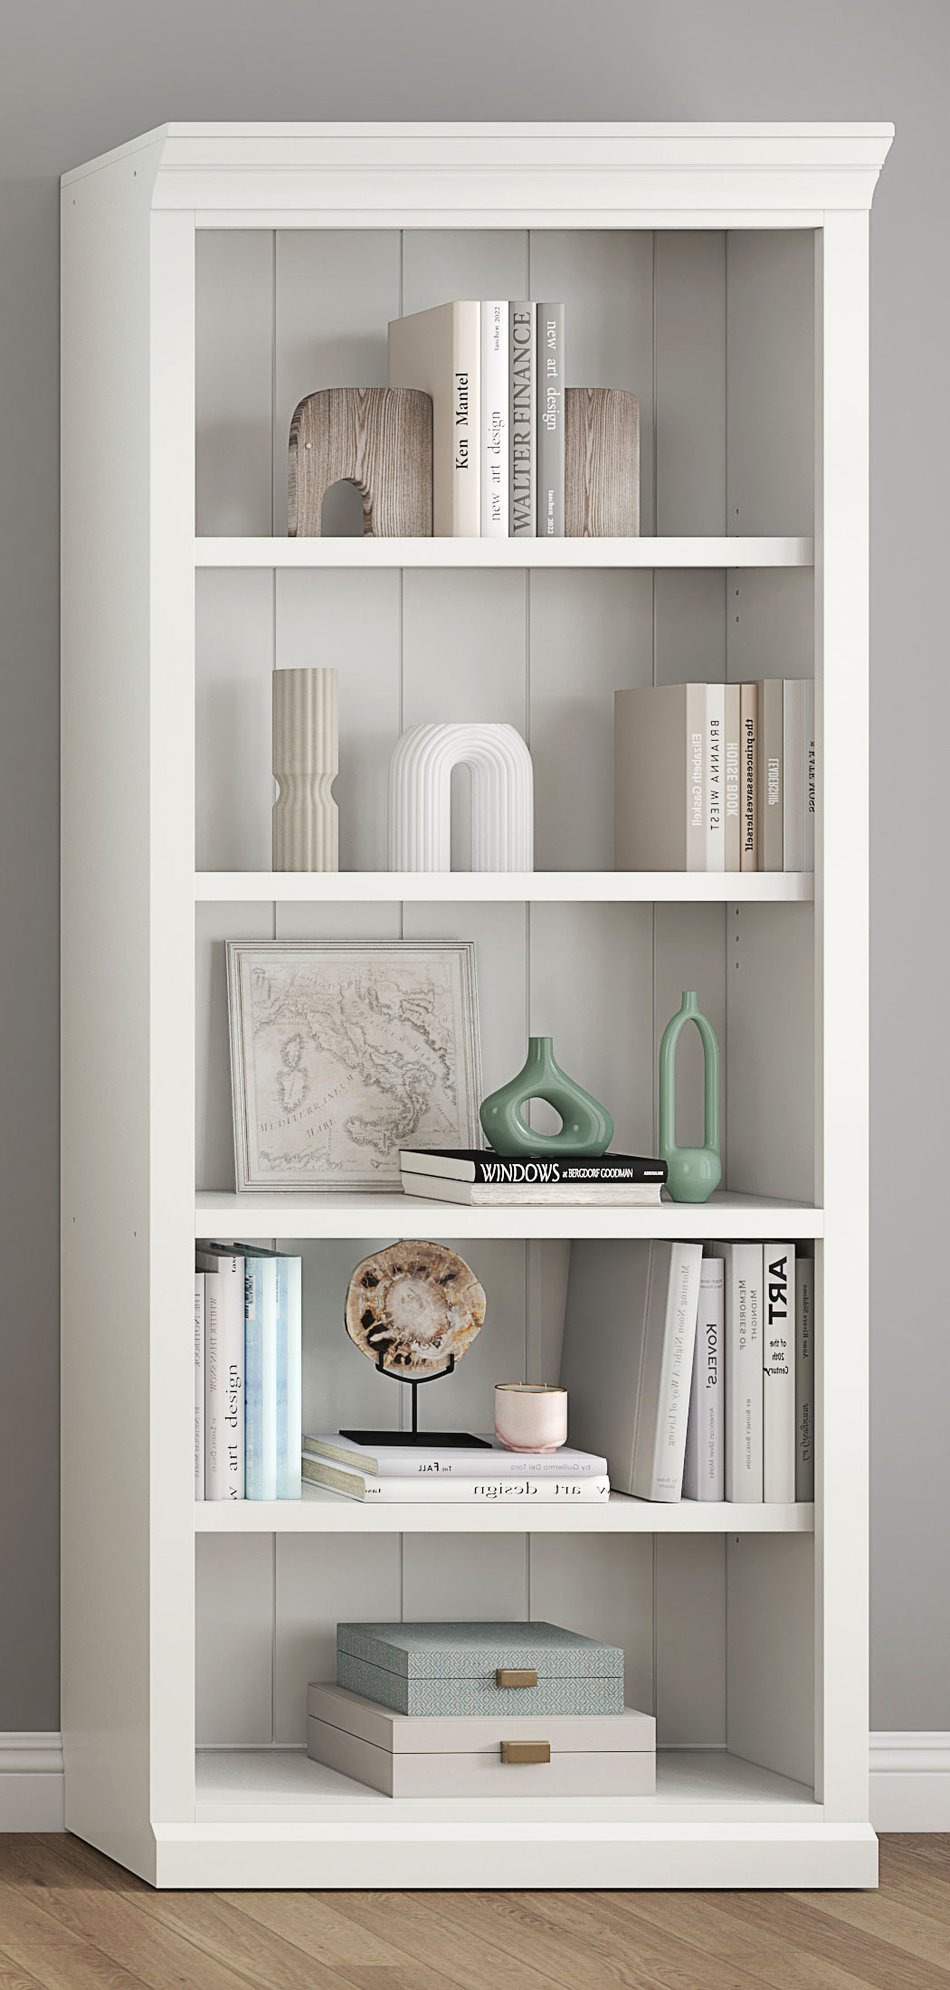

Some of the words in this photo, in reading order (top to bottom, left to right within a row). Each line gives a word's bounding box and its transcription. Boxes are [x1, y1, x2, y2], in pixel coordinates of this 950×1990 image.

[547, 321, 557, 350] new
[514, 311, 531, 426] FINANCE
[547, 358, 558, 378] art
[456, 373, 469, 426] Mantel
[543, 387, 560, 430] design
[487, 411, 505, 454] design
[456, 438, 469, 470] Ken
[491, 466, 501, 483] art
[514, 431, 531, 532] WALTER
[492, 493, 501, 521] new
[480, 1163, 560, 1182] WINDOWS
[562, 1168, 568, 1178] at
[568, 1168, 600, 1178] BERGDORF
[601, 1168, 633, 1178] GOODMAN
[224, 1364, 241, 1428] design
[227, 1443, 238, 1471] art
